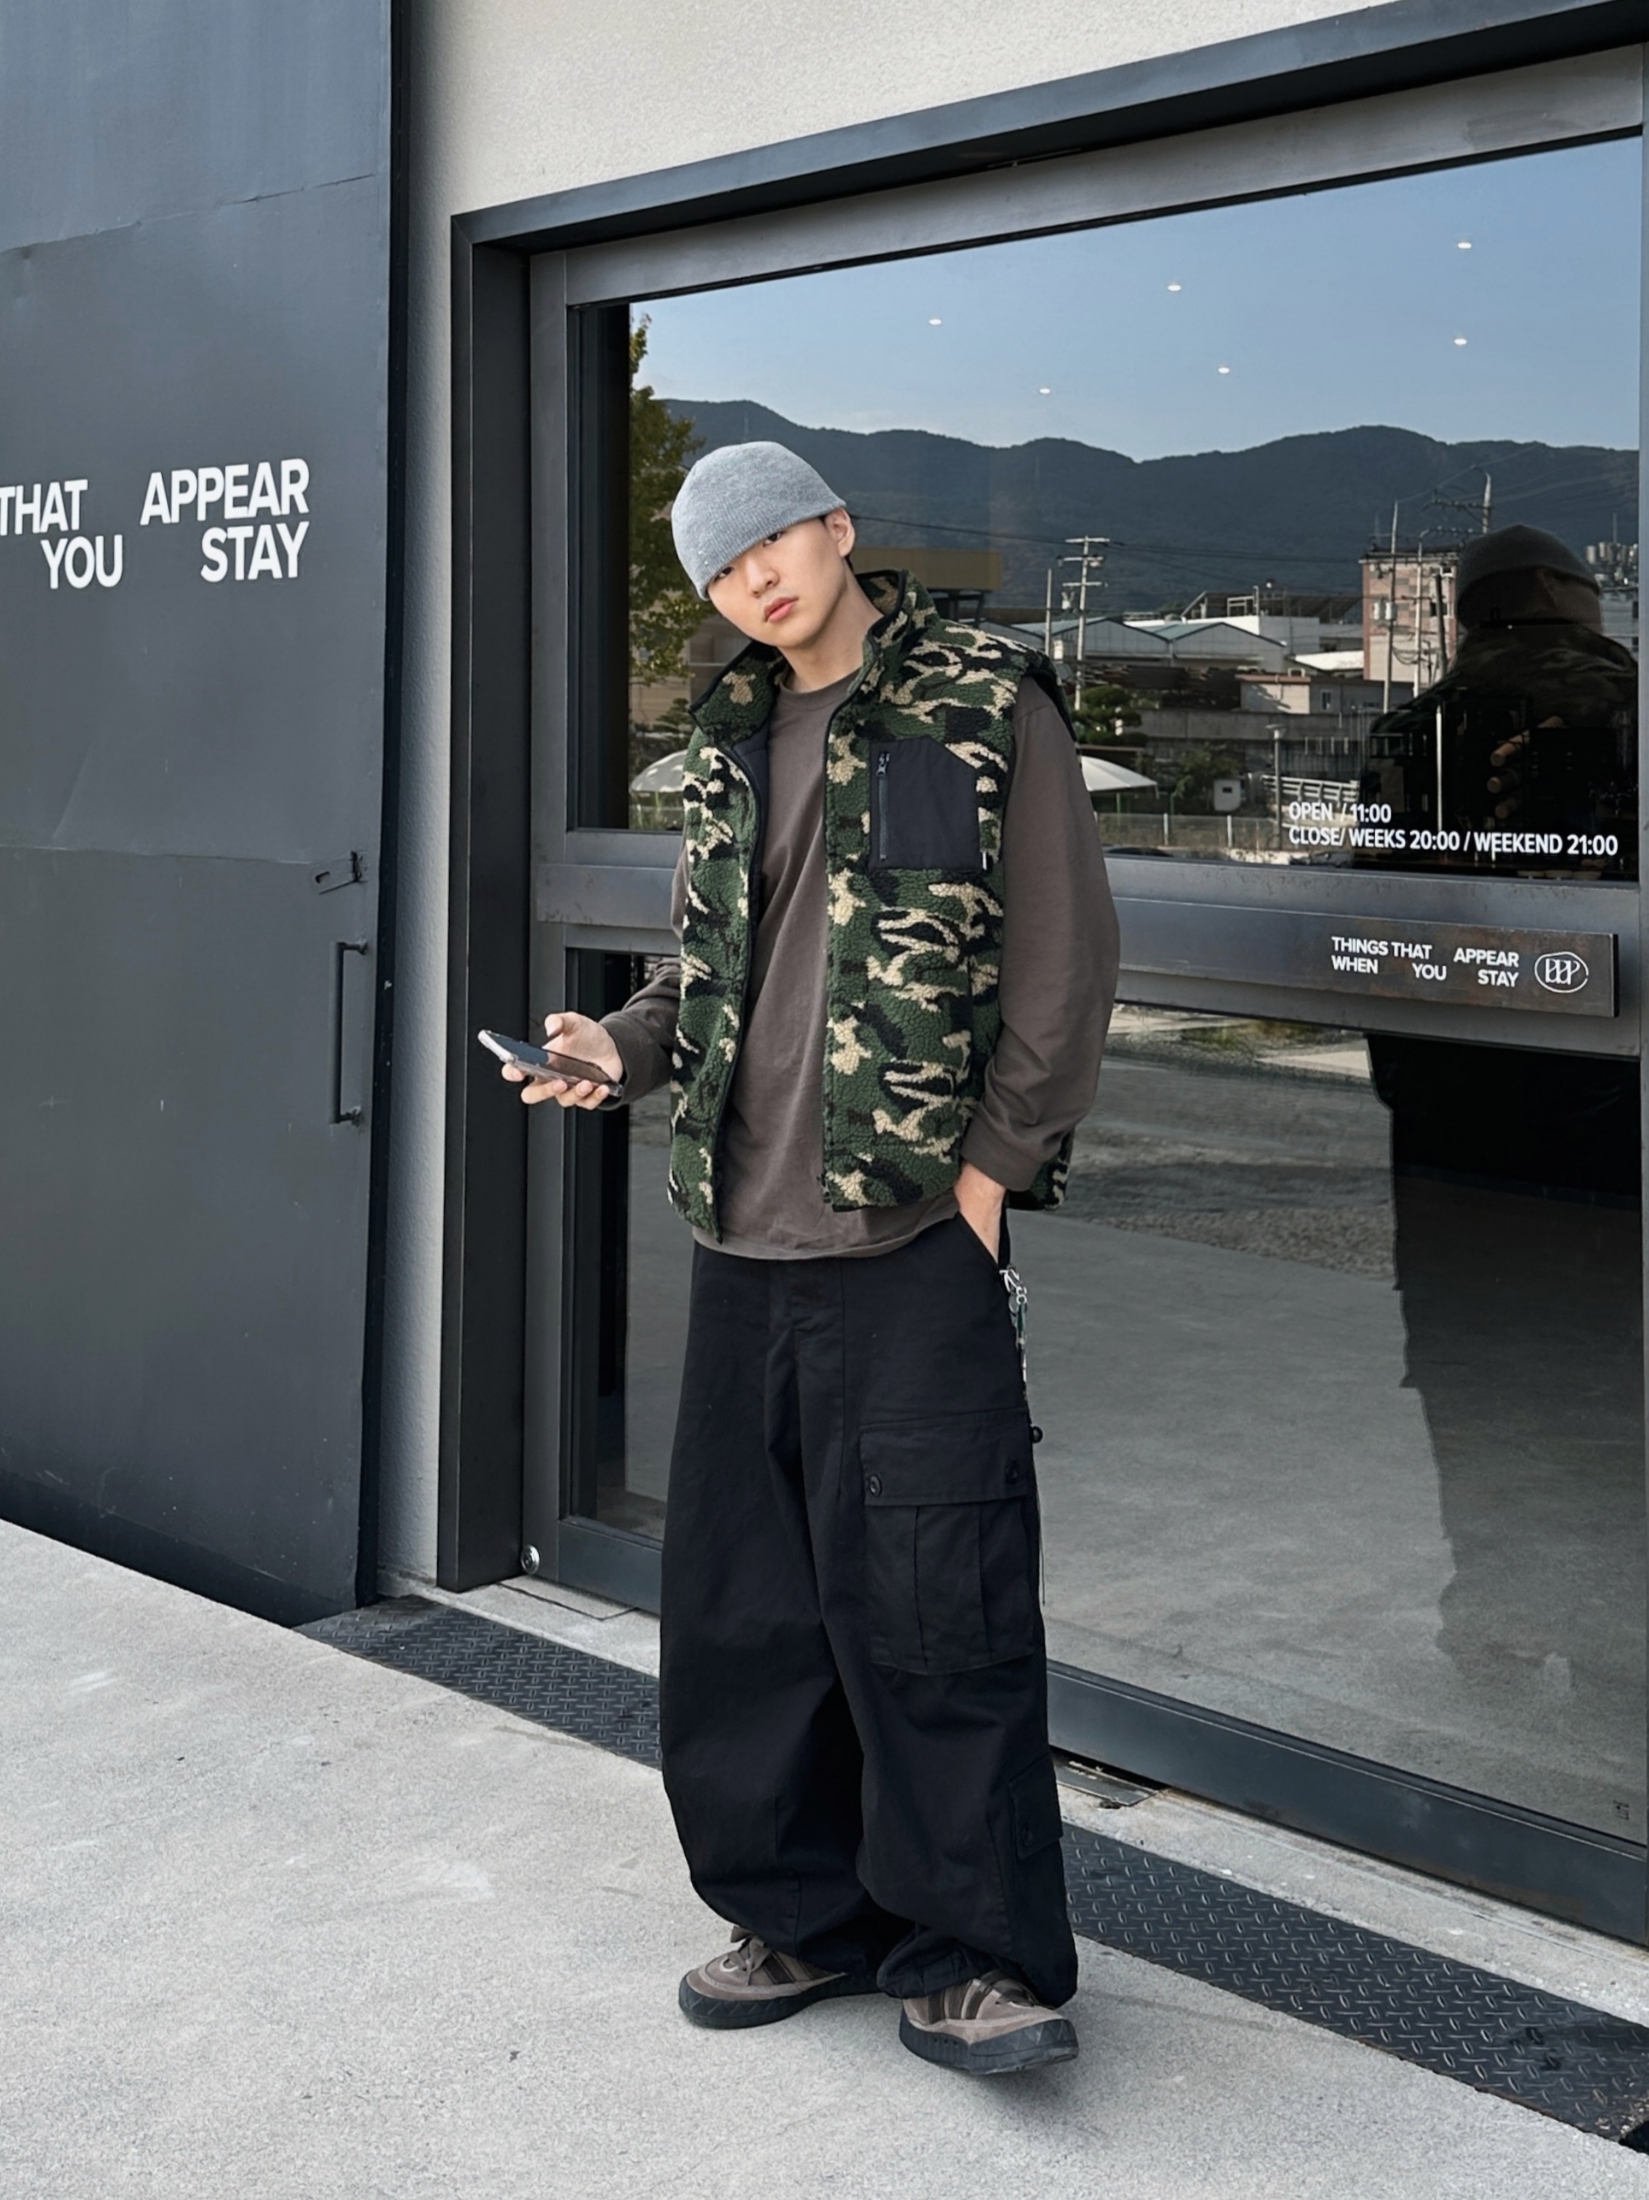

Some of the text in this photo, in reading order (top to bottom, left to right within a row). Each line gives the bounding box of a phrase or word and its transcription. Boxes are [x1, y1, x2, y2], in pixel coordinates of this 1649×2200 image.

[0, 458, 310, 536] THAT APPEAR
[40, 521, 310, 589] YOU STAY
[1288, 801, 1333, 821] OPEN
[1350, 803, 1392, 823] 11:00
[1349, 828, 1406, 849] WEEKS
[1409, 829, 1460, 851] 20:00
[1474, 832, 1563, 854] WEEKEND
[1567, 834, 1618, 856] 21:00
[1331, 936, 1519, 968] THINGS THAT APPEAR
[1331, 955, 1519, 988] WHEN YOU STAY
